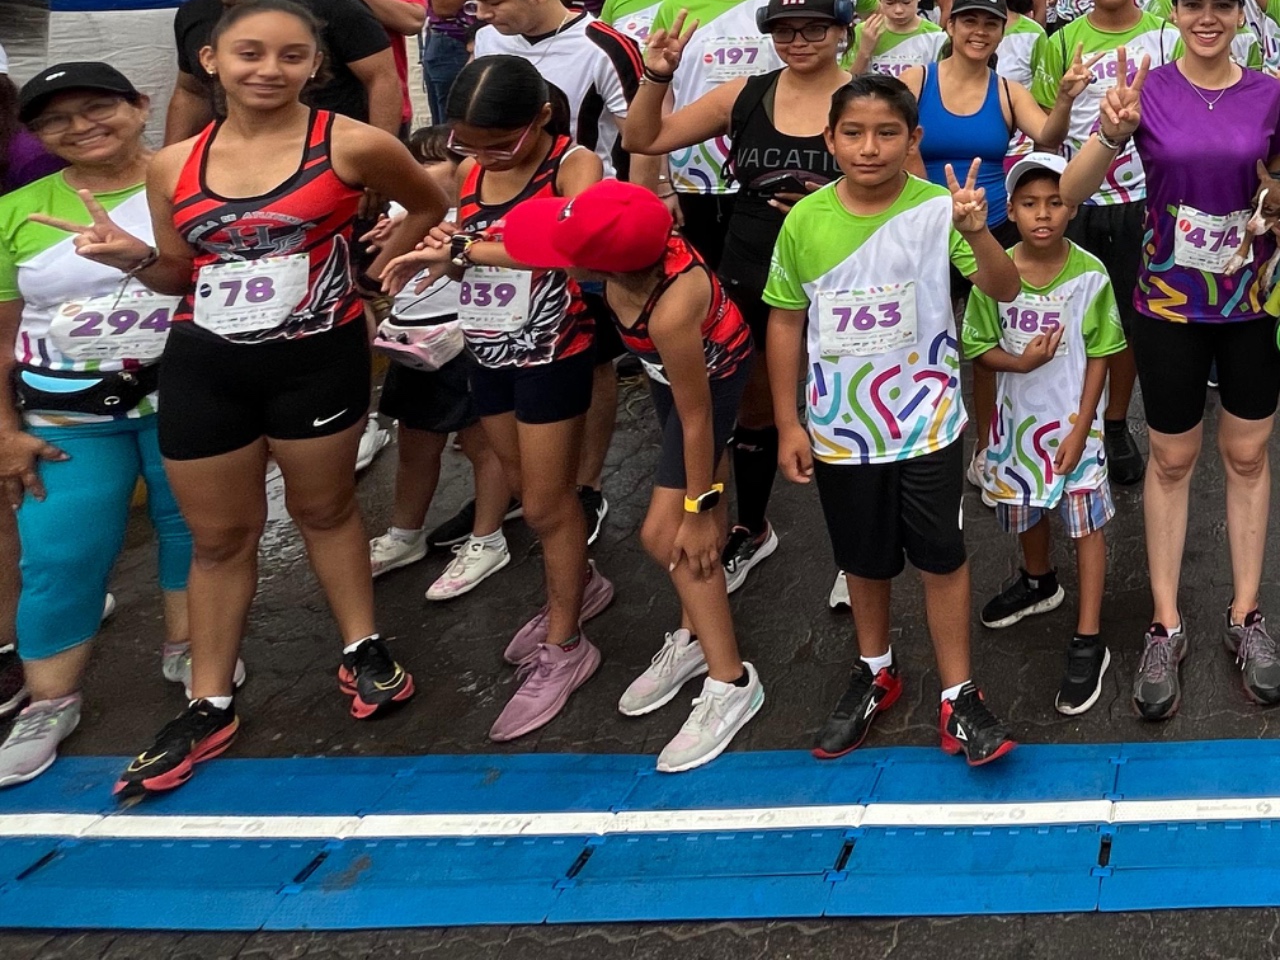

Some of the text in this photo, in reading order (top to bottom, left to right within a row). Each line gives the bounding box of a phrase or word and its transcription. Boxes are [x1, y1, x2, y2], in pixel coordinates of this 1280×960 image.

[713, 47, 759, 65] 197
[1185, 225, 1242, 252] 474
[219, 276, 276, 307] 78
[69, 307, 172, 338] 294
[832, 301, 902, 332] 763
[1006, 306, 1061, 335] 185
